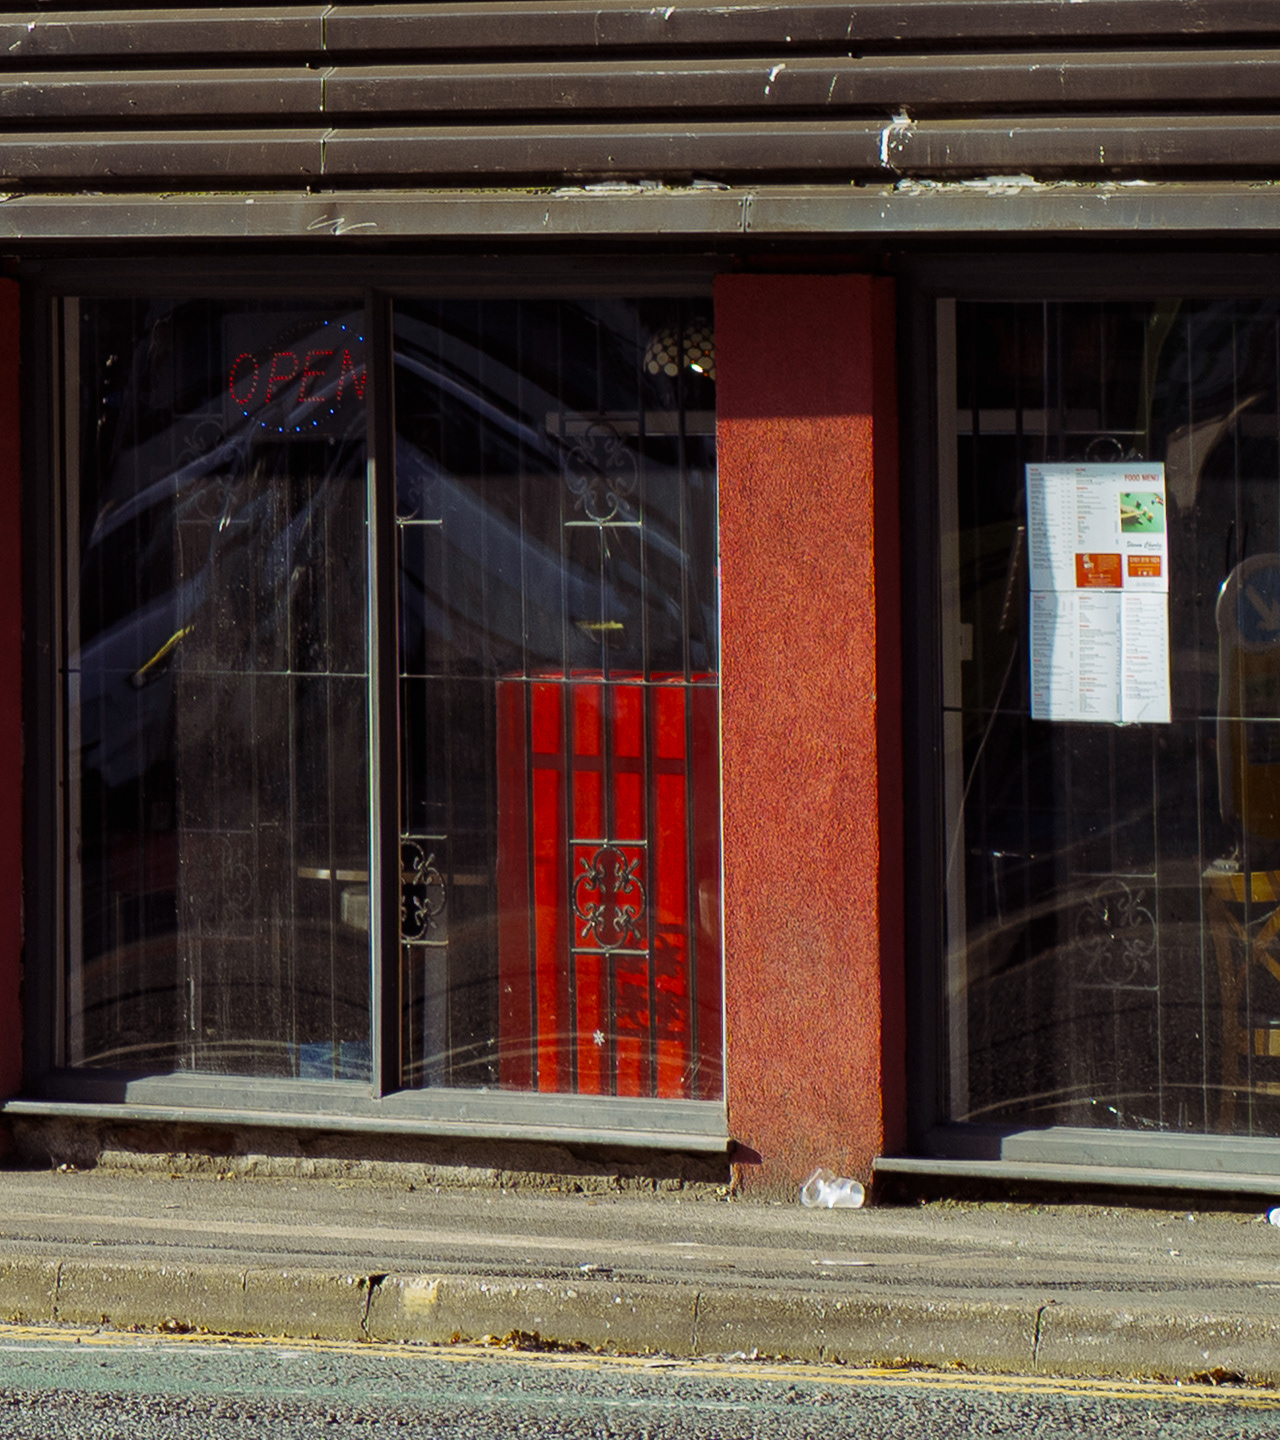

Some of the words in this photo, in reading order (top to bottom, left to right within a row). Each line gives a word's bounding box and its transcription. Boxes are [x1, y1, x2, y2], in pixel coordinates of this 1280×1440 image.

[229, 349, 367, 404] OPEN
[1124, 474, 1141, 482] FOOD
[1142, 474, 1159, 482] MENU
